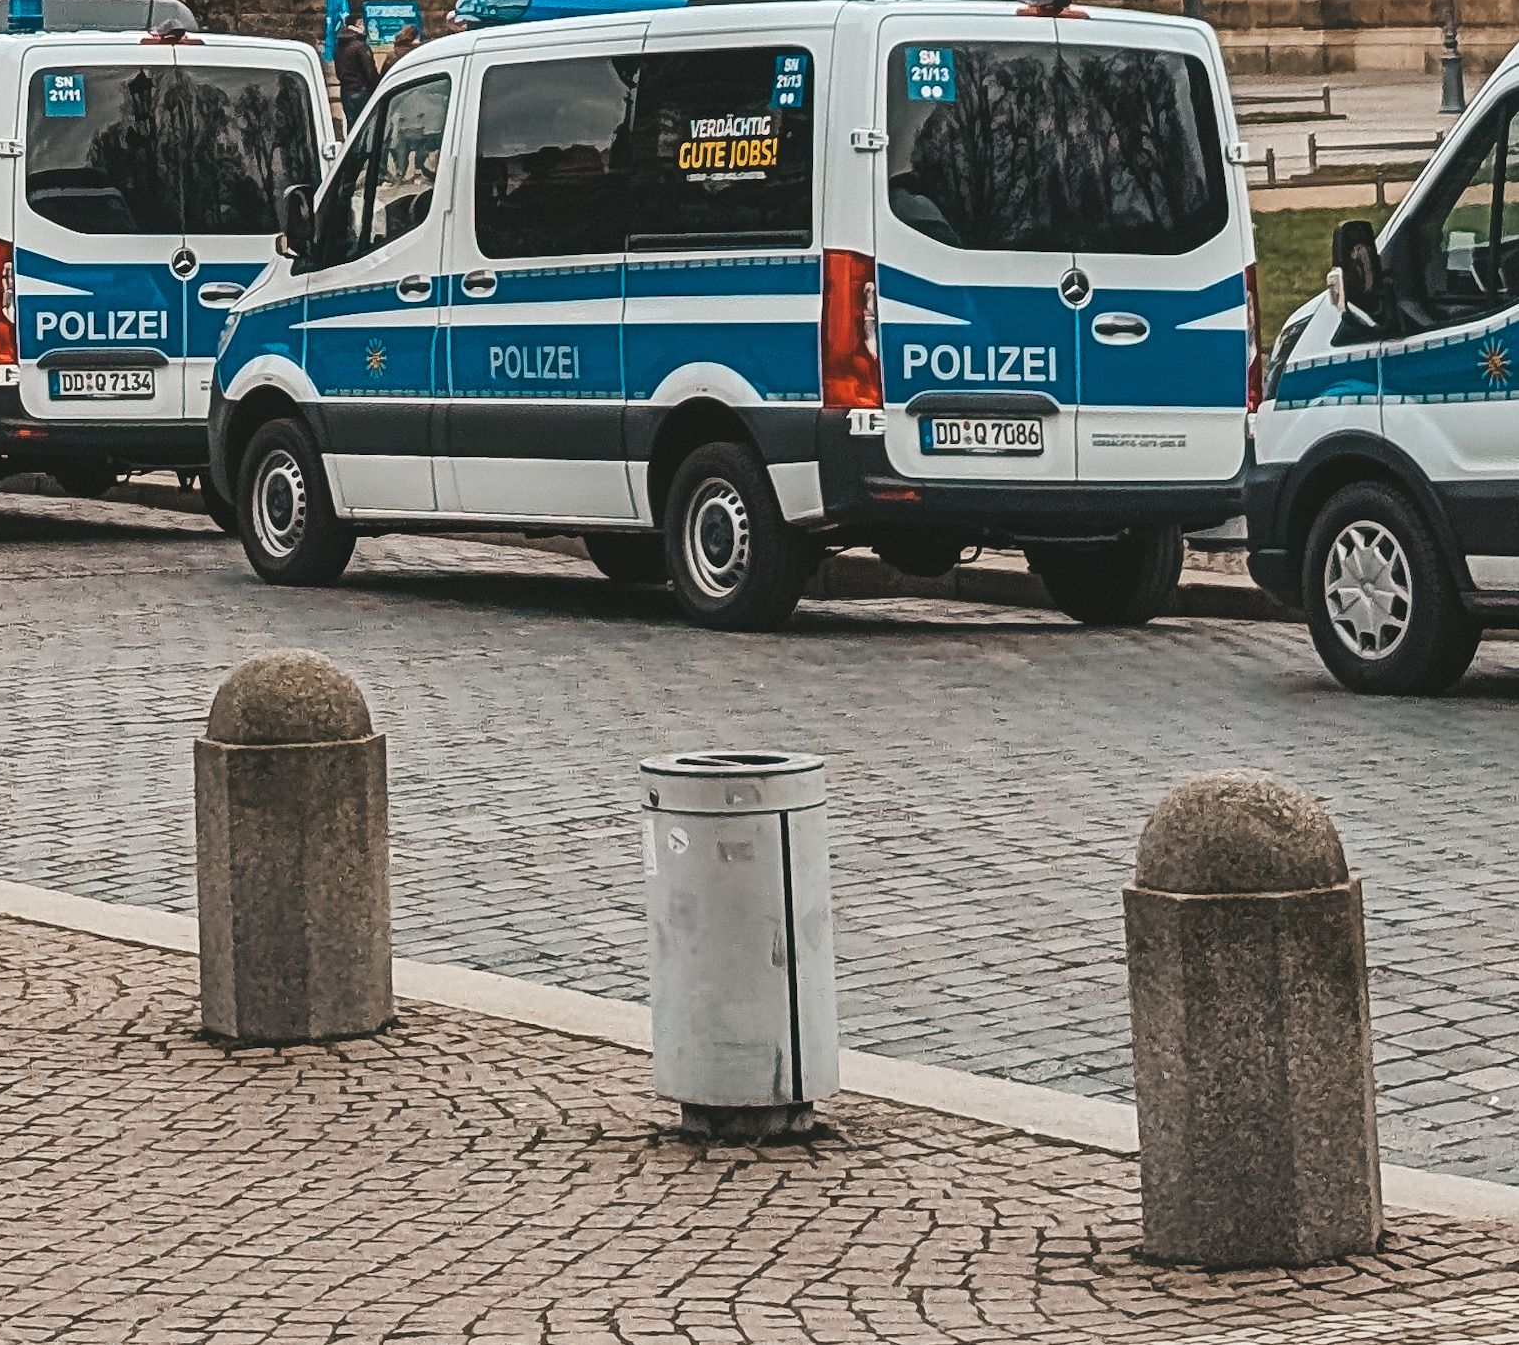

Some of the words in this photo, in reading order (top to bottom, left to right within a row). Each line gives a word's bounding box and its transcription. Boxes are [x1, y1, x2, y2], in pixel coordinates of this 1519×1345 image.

[911, 66, 950, 82] 21/13
[679, 141, 727, 170] GUTE
[728, 138, 779, 169] JOBS!
[36, 310, 168, 341] POLIZEI
[489, 345, 580, 380] POLIZEI
[903, 344, 1057, 382] POLIZEI
